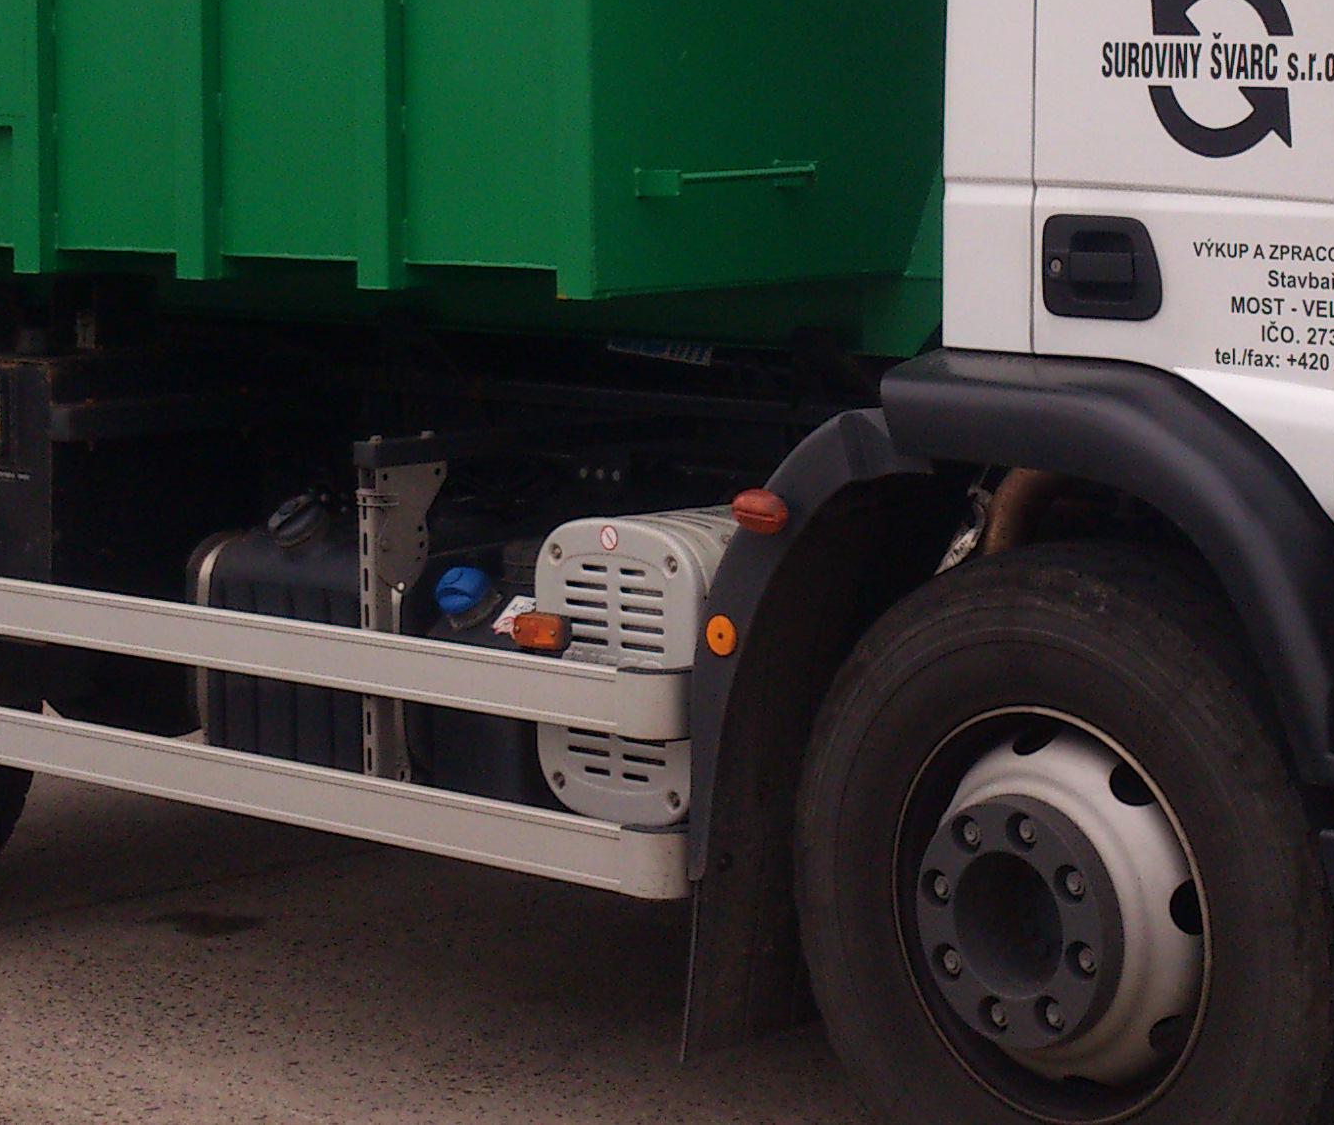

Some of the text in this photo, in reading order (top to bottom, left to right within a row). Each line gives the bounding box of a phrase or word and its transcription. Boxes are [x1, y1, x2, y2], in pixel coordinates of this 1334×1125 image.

[1102, 40, 1202, 80] SUROVINY
[1210, 32, 1278, 81] ŠVARC
[1193, 238, 1249, 259] VÝKUP
[1253, 244, 1265, 260] A
[1230, 296, 1285, 315] MOST
[1261, 321, 1300, 344] IČO.
[1215, 348, 1280, 368] tel./fax:
[1287, 353, 1330, 371] +420
